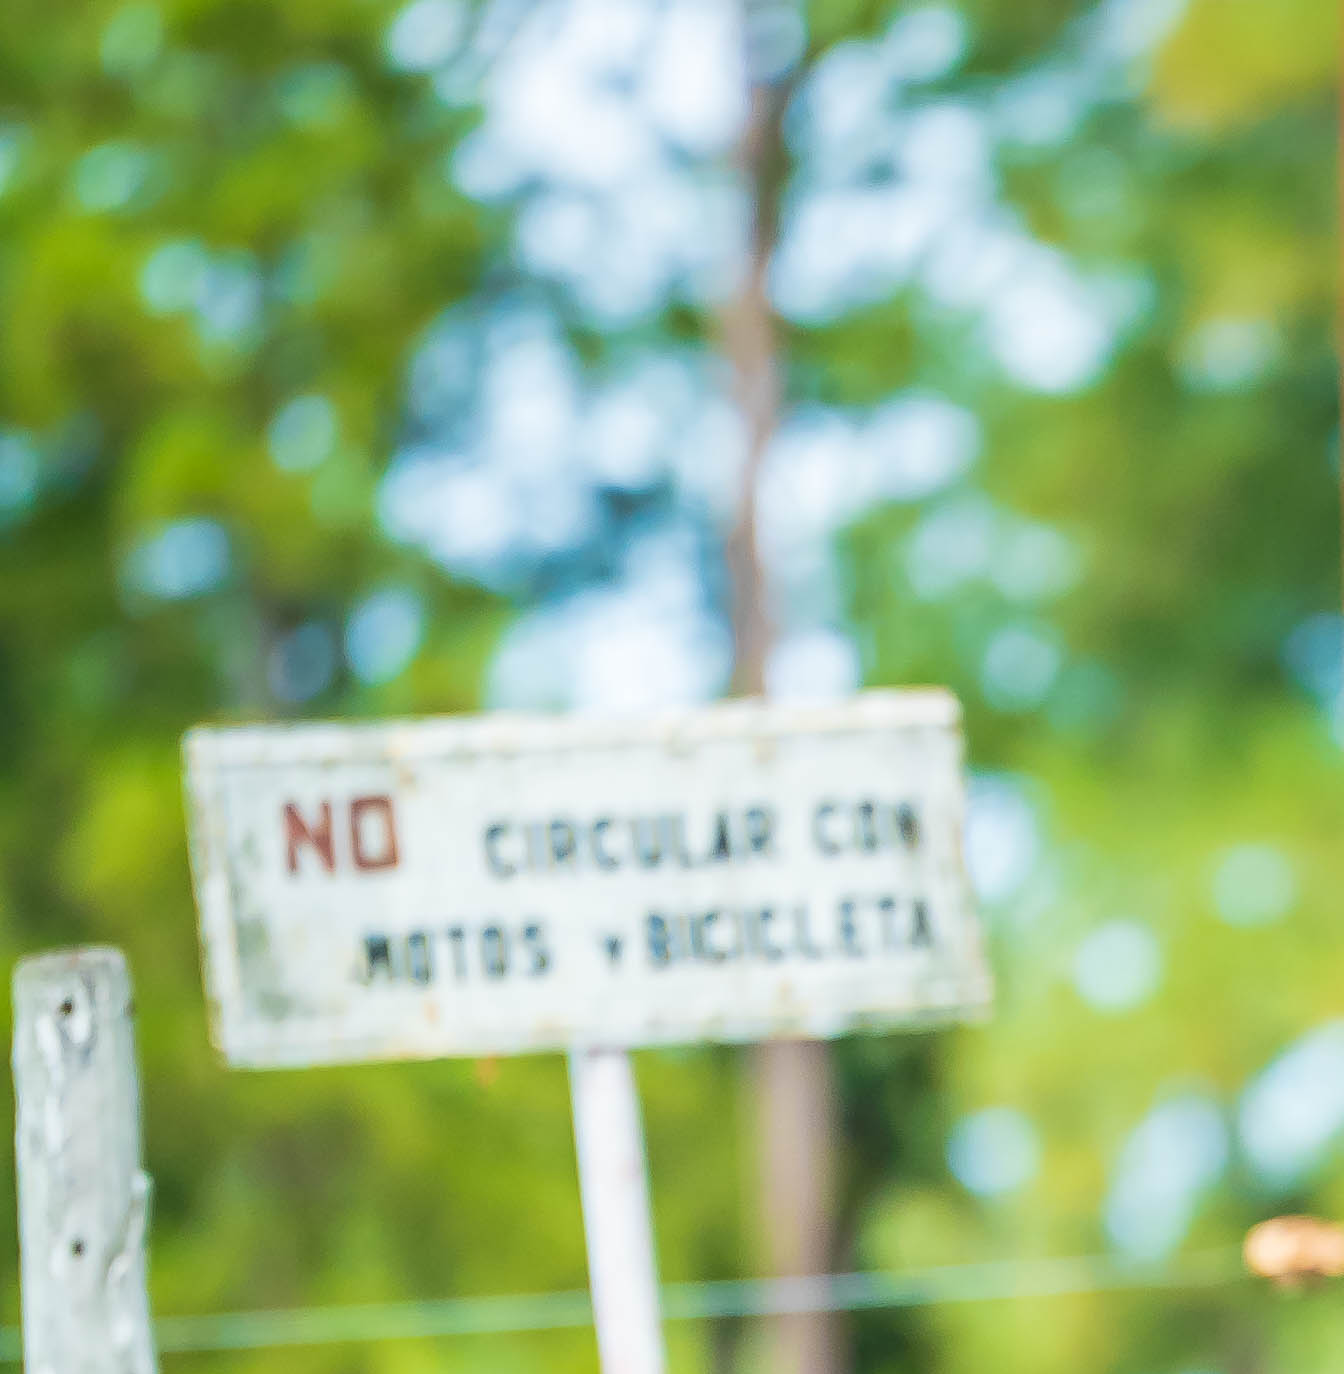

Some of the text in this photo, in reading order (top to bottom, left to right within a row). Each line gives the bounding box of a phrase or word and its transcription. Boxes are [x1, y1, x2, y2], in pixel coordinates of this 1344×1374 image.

[283, 795, 922, 880] NO CIRCULAR CON
[358, 922, 555, 984] MOTOS
[645, 897, 936, 968] BICICLETA
